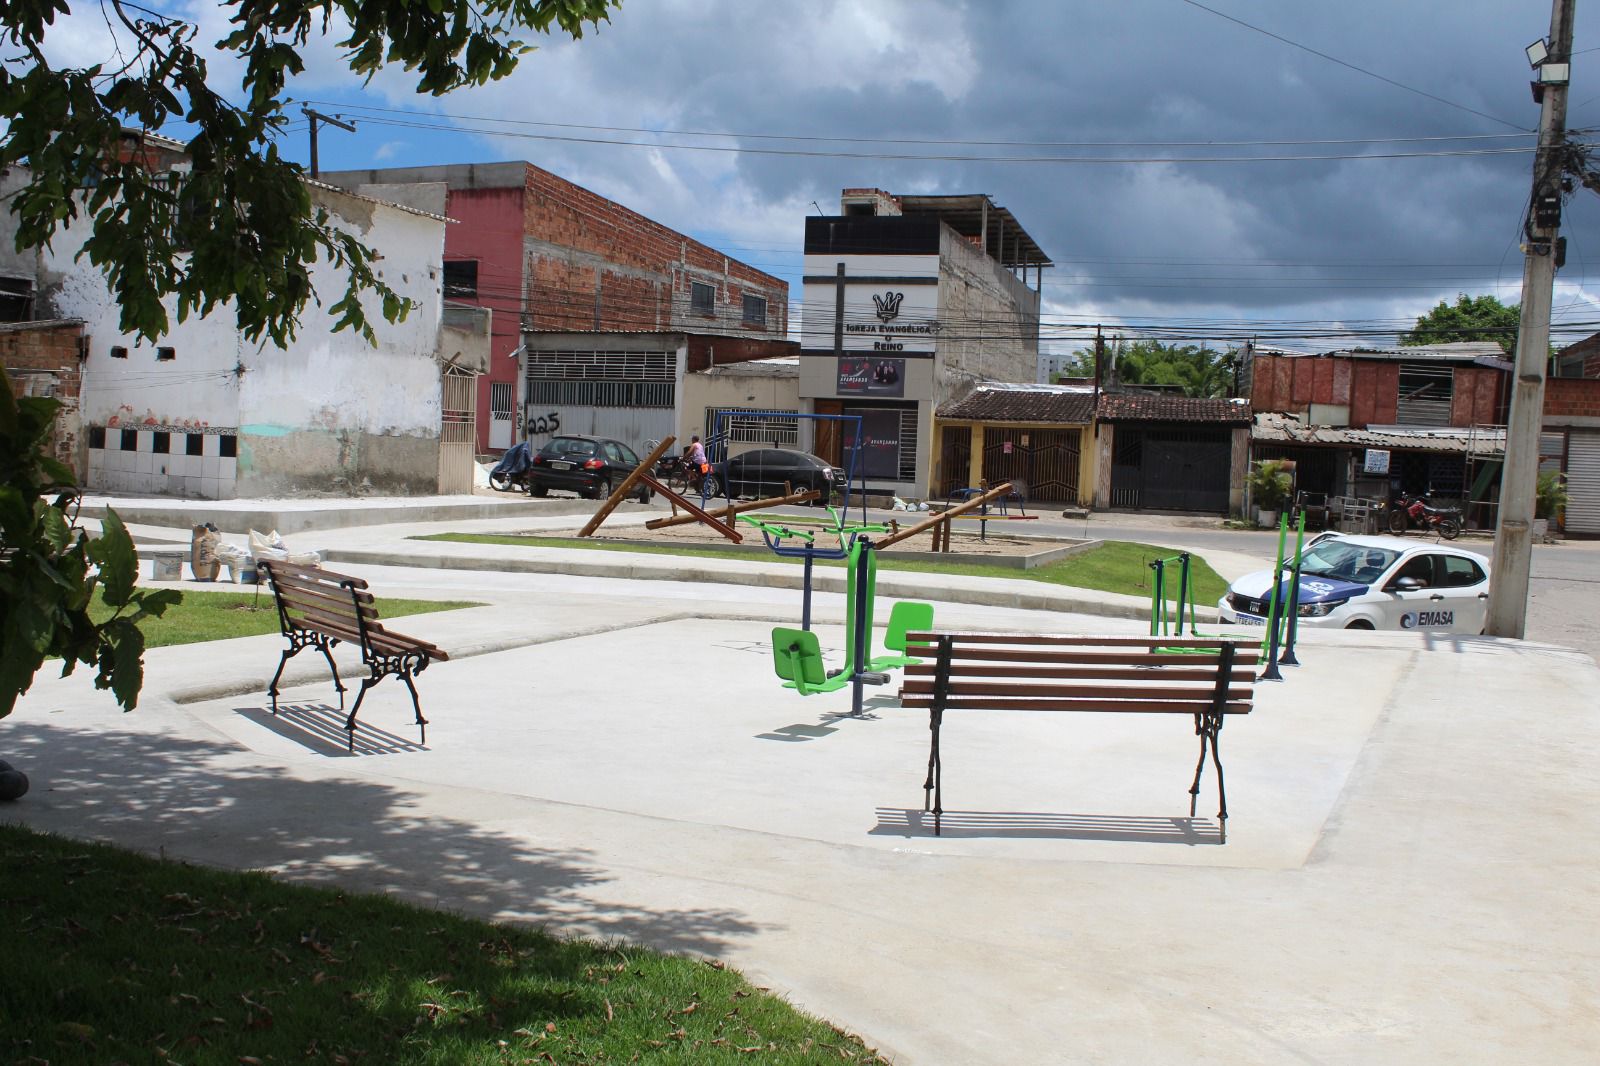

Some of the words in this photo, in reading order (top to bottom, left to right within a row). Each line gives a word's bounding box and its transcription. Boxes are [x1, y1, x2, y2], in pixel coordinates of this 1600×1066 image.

[874, 341, 903, 351] REINO
[528, 412, 560, 434] 225
[1418, 611, 1454, 626] EMASA
